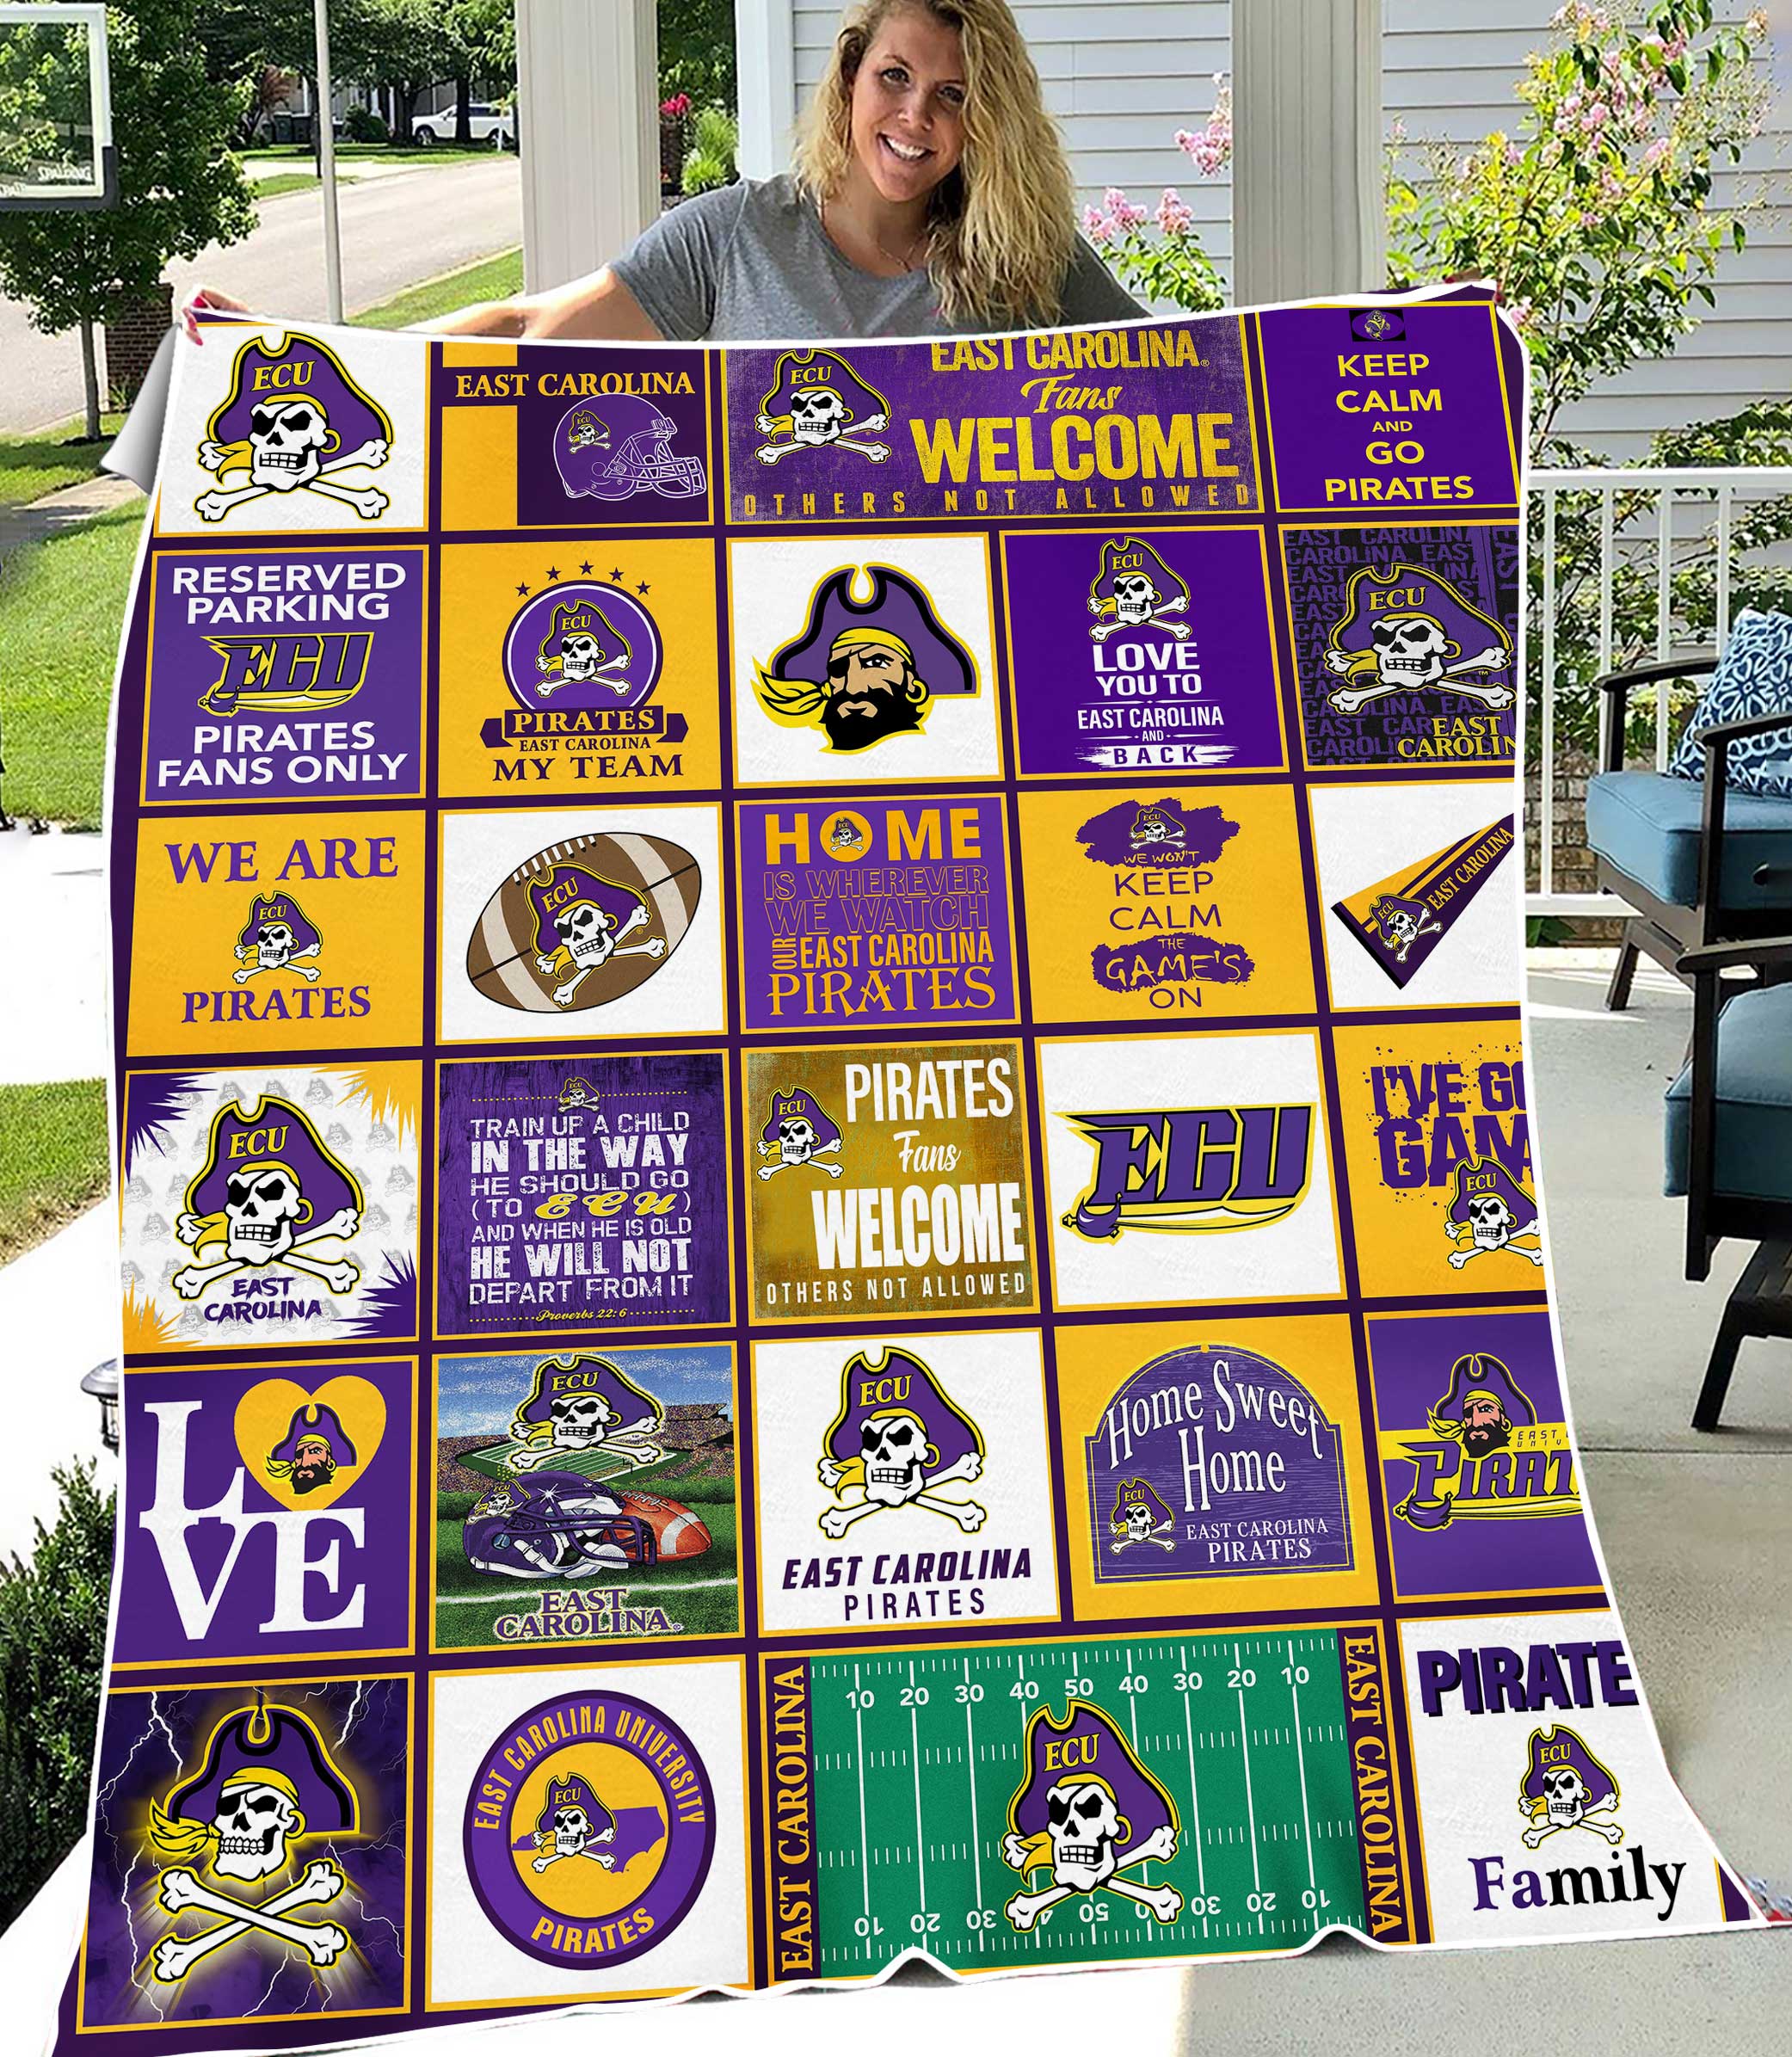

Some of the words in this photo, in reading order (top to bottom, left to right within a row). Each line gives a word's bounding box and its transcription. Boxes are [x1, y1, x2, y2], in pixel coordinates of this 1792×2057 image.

[931, 337, 1020, 372] EAST
[1338, 354, 1430, 377] KEEP
[250, 360, 317, 392] ECU
[455, 374, 529, 398] EAST
[538, 372, 695, 396] CAROLINA
[789, 366, 833, 385] ECU
[1020, 373, 1123, 415] Fans
[1336, 389, 1443, 413] CALM
[1372, 421, 1413, 433] AND
[909, 413, 1239, 483] WELCOME
[1365, 440, 1425, 465] GO
[744, 490, 906, 515] OTHERS
[944, 488, 1016, 512] NOT
[1056, 483, 1250, 509] ALLOWED
[1325, 475, 1474, 502] PIRATES
[1284, 529, 1344, 546] EAST
[1112, 552, 1143, 570] ECU
[1285, 545, 1407, 564] CAROLINA
[173, 563, 407, 594] RESERVED
[187, 593, 390, 624] PARKING
[1369, 587, 1426, 611] ECU
[561, 614, 592, 631] ECU
[200, 631, 375, 693] ECU
[1093, 642, 1200, 672] LOVE
[1095, 674, 1157, 696] YOU
[1163, 674, 1202, 694] TO
[513, 709, 655, 733] PIRATES
[1077, 708, 1124, 730] EAST
[1130, 705, 1224, 728] CAROLINA
[1305, 717, 1366, 737] EAST
[1432, 716, 1501, 737] EAST
[194, 721, 375, 754] PIRATES
[520, 738, 559, 752] EAST
[564, 736, 651, 751] CAROLINA
[1142, 730, 1164, 742] AND
[492, 757, 556, 782] MY
[570, 754, 684, 779] TEAM
[1114, 746, 1198, 765] BACK
[158, 756, 274, 787] FANS
[286, 753, 409, 784] ONLY
[1143, 813, 1161, 822] ECU
[164, 841, 259, 884] WE
[275, 836, 398, 881] ARE
[1123, 853, 1148, 864] WE
[1152, 850, 1200, 863] WON'T
[1426, 876, 1461, 911] EAST
[1455, 827, 1514, 885] CAROLINA
[540, 877, 580, 914] ECU
[764, 871, 796, 901] IS
[805, 865, 989, 899] WHEREVER
[1114, 871, 1214, 896] KEEP
[258, 905, 287, 921] ECU
[764, 899, 831, 936] WE
[841, 895, 989, 933] WATCH
[1109, 904, 1222, 931] CALM
[1377, 901, 1395, 920] ECU
[772, 938, 798, 970] OUR
[799, 935, 862, 969] EAST
[869, 931, 995, 967] CAROLINA
[1158, 938, 1186, 950] THE
[1105, 950, 1241, 987] GAME'S
[181, 985, 371, 1024] PIRATES
[767, 966, 996, 1018] PIRATES
[1149, 987, 1203, 1009] ON
[845, 1057, 1013, 1123] PIRATES
[778, 1099, 806, 1115] ECU
[471, 1117, 544, 1138] TRAIN
[551, 1116, 584, 1135] UP
[593, 1115, 610, 1134] A
[618, 1112, 690, 1132] CHILD
[227, 1125, 290, 1159] ECU
[471, 1140, 509, 1173] IN
[523, 1137, 586, 1171] THE
[600, 1133, 688, 1168] WAY
[893, 1130, 961, 1173] Fans
[1050, 1102, 1317, 1206] ECU
[471, 1177, 509, 1196] HE
[520, 1171, 640, 1194] SHOULD
[650, 1170, 689, 1189] GO
[1465, 1173, 1498, 1192] ECU
[471, 1225, 514, 1243] AND
[521, 1222, 585, 1241] WHEN
[592, 1220, 619, 1238] HE
[625, 1219, 644, 1236] IS
[650, 1217, 692, 1235] OLD
[810, 1182, 1025, 1270] WELCOME
[471, 1246, 510, 1279] HE
[524, 1241, 609, 1278] WILL
[623, 1238, 692, 1273] NOT
[231, 1277, 297, 1300] EAST
[469, 1280, 572, 1305] DEPART
[586, 1276, 662, 1300] FROM
[671, 1274, 693, 1296] IT
[767, 1280, 853, 1305] OTHERS
[867, 1277, 908, 1300] NOT
[922, 1272, 1025, 1298] ALLOWED
[204, 1300, 323, 1325] CAROLINA
[536, 1309, 594, 1322] Proverbs
[551, 1371, 600, 1392] ECU
[859, 1375, 913, 1407] ECU
[1106, 1382, 1204, 1470] Home
[1212, 1359, 1323, 1460] Sweet
[1518, 1429, 1557, 1440] EAST
[1179, 1426, 1286, 1512] Home
[1124, 1489, 1145, 1502] ECU
[1186, 1522, 1231, 1541] EAST
[1237, 1518, 1328, 1537] CAROLINA
[1208, 1538, 1312, 1563] PIRATES
[782, 1556, 863, 1589] EAST
[872, 1548, 1031, 1584] CAROLINA
[542, 1590, 627, 1614] EAST
[844, 1588, 984, 1621] PIRATES
[846, 1691, 875, 1709] 10
[900, 1687, 929, 1706] 20
[954, 1684, 984, 1703] 30
[1009, 1681, 1039, 1700] 40
[1064, 1678, 1094, 1697] 50
[1119, 1676, 1148, 1694] 40
[1173, 1672, 1203, 1691] 30
[1227, 1669, 1257, 1688] 20
[1281, 1666, 1309, 1684] 10
[1344, 1635, 1383, 1726] EAST
[1417, 1640, 1639, 1717] PIRATE
[773, 1665, 811, 1865] CAROLINA
[1044, 1732, 1100, 1772] ECU
[1540, 1743, 1571, 1764] ECU
[474, 1768, 513, 1830] EAST
[503, 1705, 606, 1771] CAROLINA
[615, 1709, 705, 1823] UNIVERSITY
[553, 1787, 582, 1805] ECU
[1354, 1736, 1403, 1937] CAROLINA
[1468, 1845, 1686, 1921] Family
[1191, 1895, 1221, 1915] 30
[1247, 1892, 1277, 1912] 20
[1302, 1889, 1331, 1909] 10
[779, 1876, 814, 1973] EAST
[910, 1912, 941, 1933] 20
[966, 1909, 997, 1930] 30
[1079, 1902, 1110, 1923] 50
[531, 1907, 655, 1954] PIRATES
[854, 1916, 884, 1937] 10
